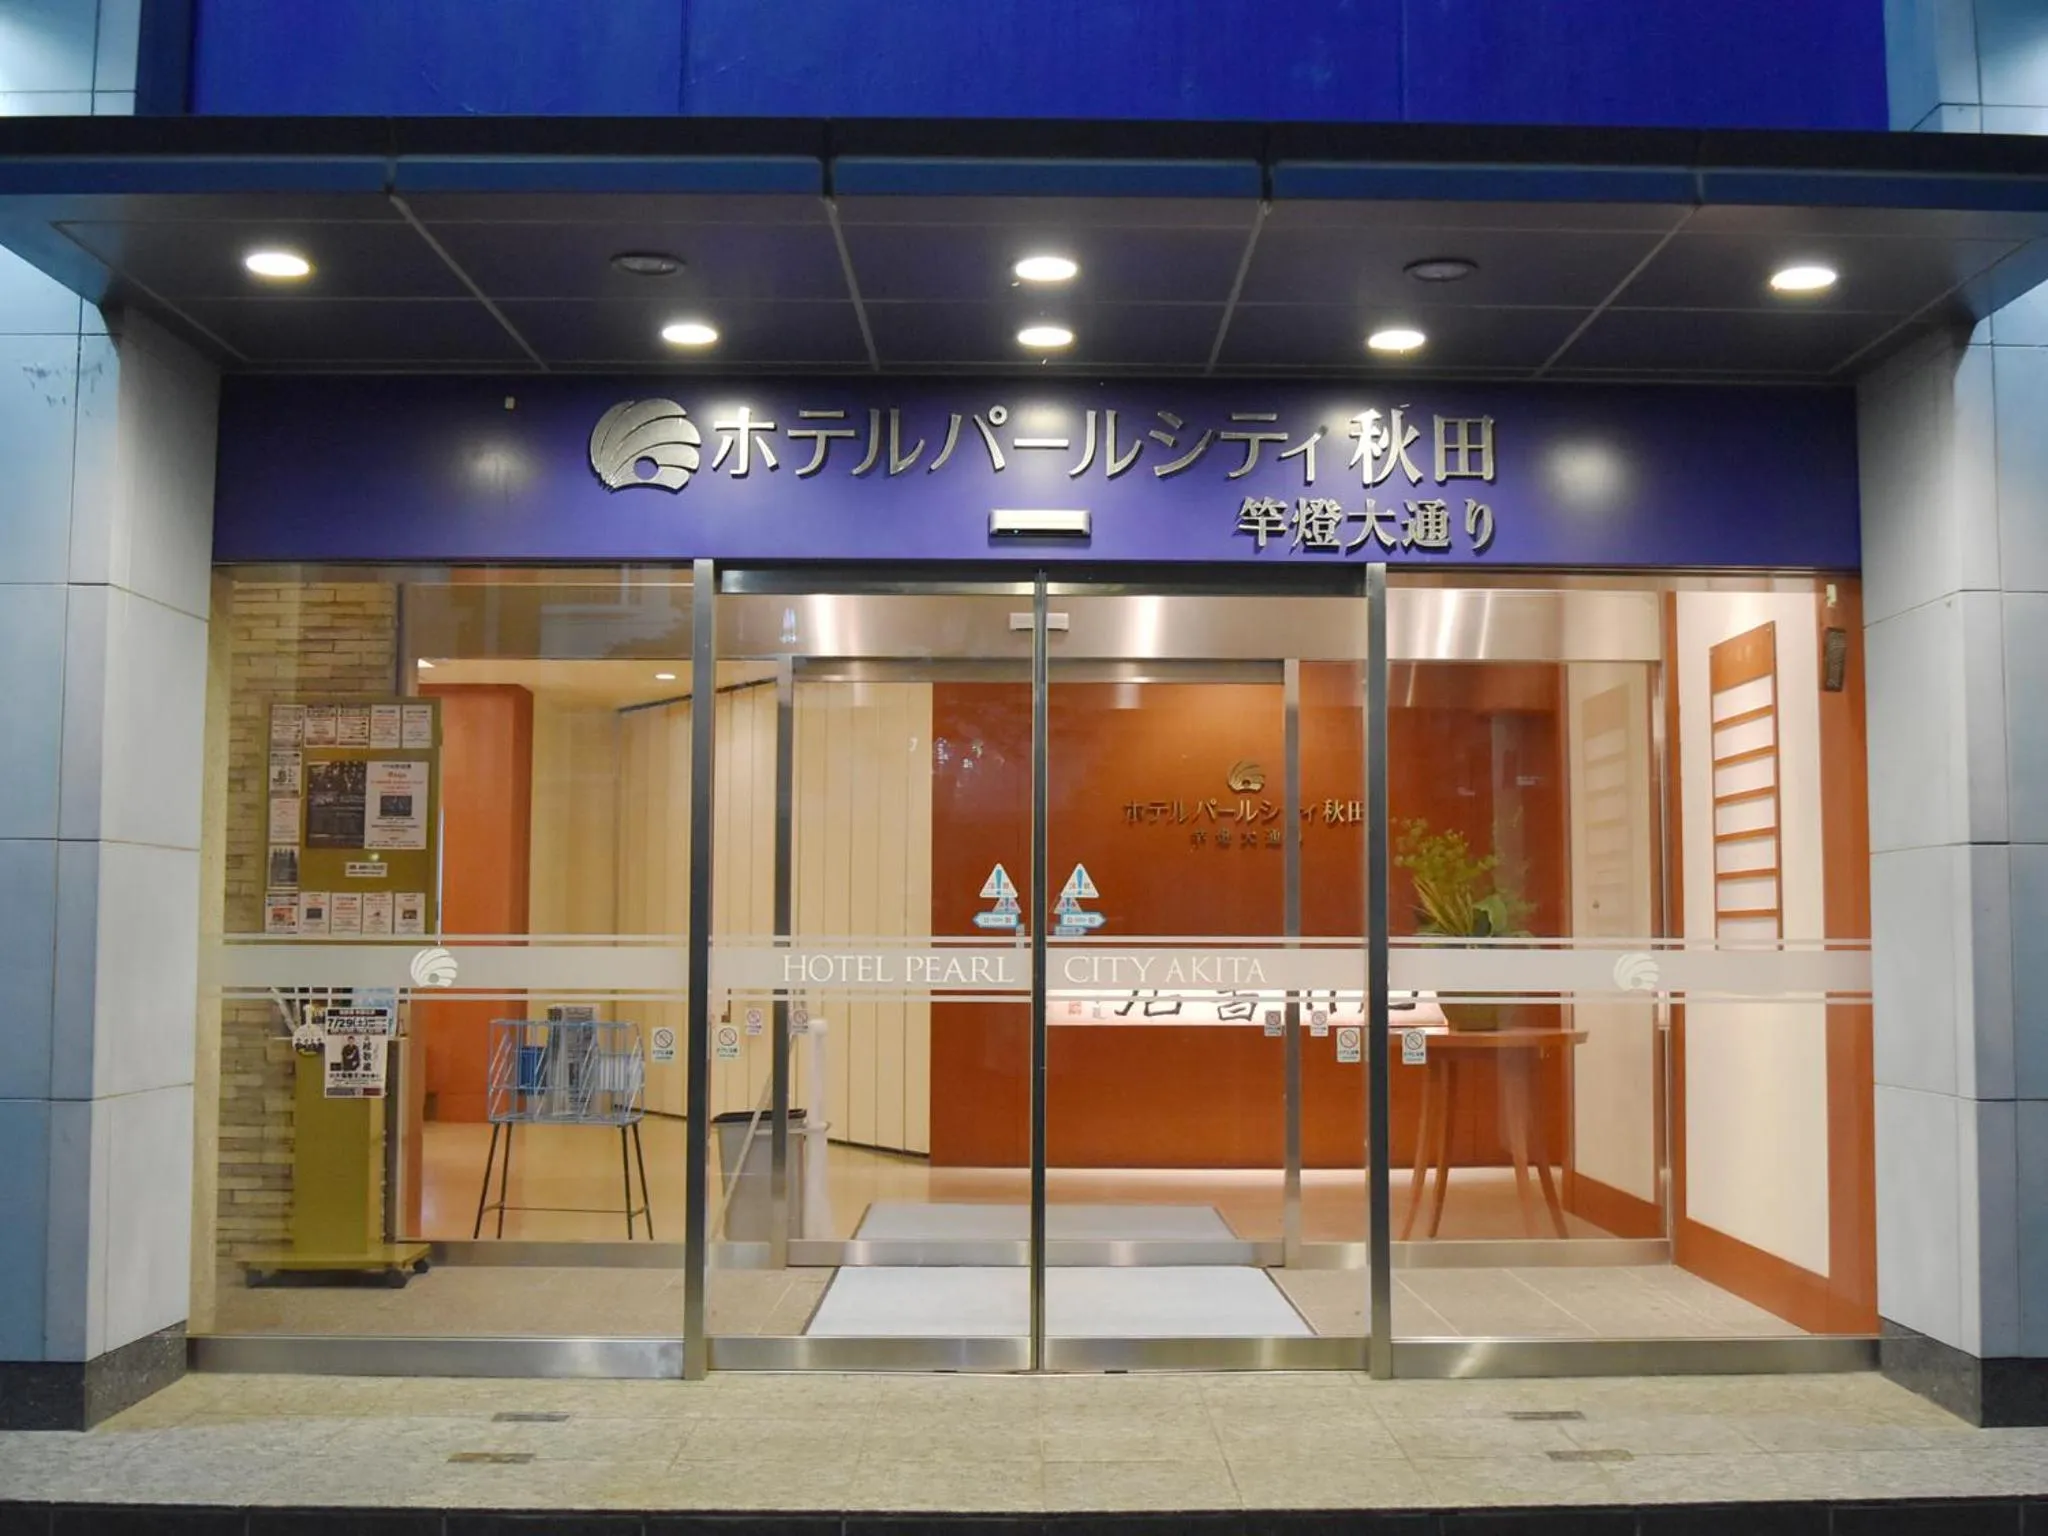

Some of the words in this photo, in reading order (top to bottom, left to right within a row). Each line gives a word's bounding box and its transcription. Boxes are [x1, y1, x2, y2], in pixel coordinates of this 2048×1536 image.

[711, 405, 1495, 485] ホテルパールシティ秋田
[1238, 497, 1495, 553] 竿燈大通り
[1124, 798, 1364, 824] ホテルパールシィ秋田
[783, 954, 894, 983] HOTEL
[905, 955, 1015, 984] PEARL
[1064, 955, 1156, 983] CITY
[1165, 956, 1268, 984] AKITA
